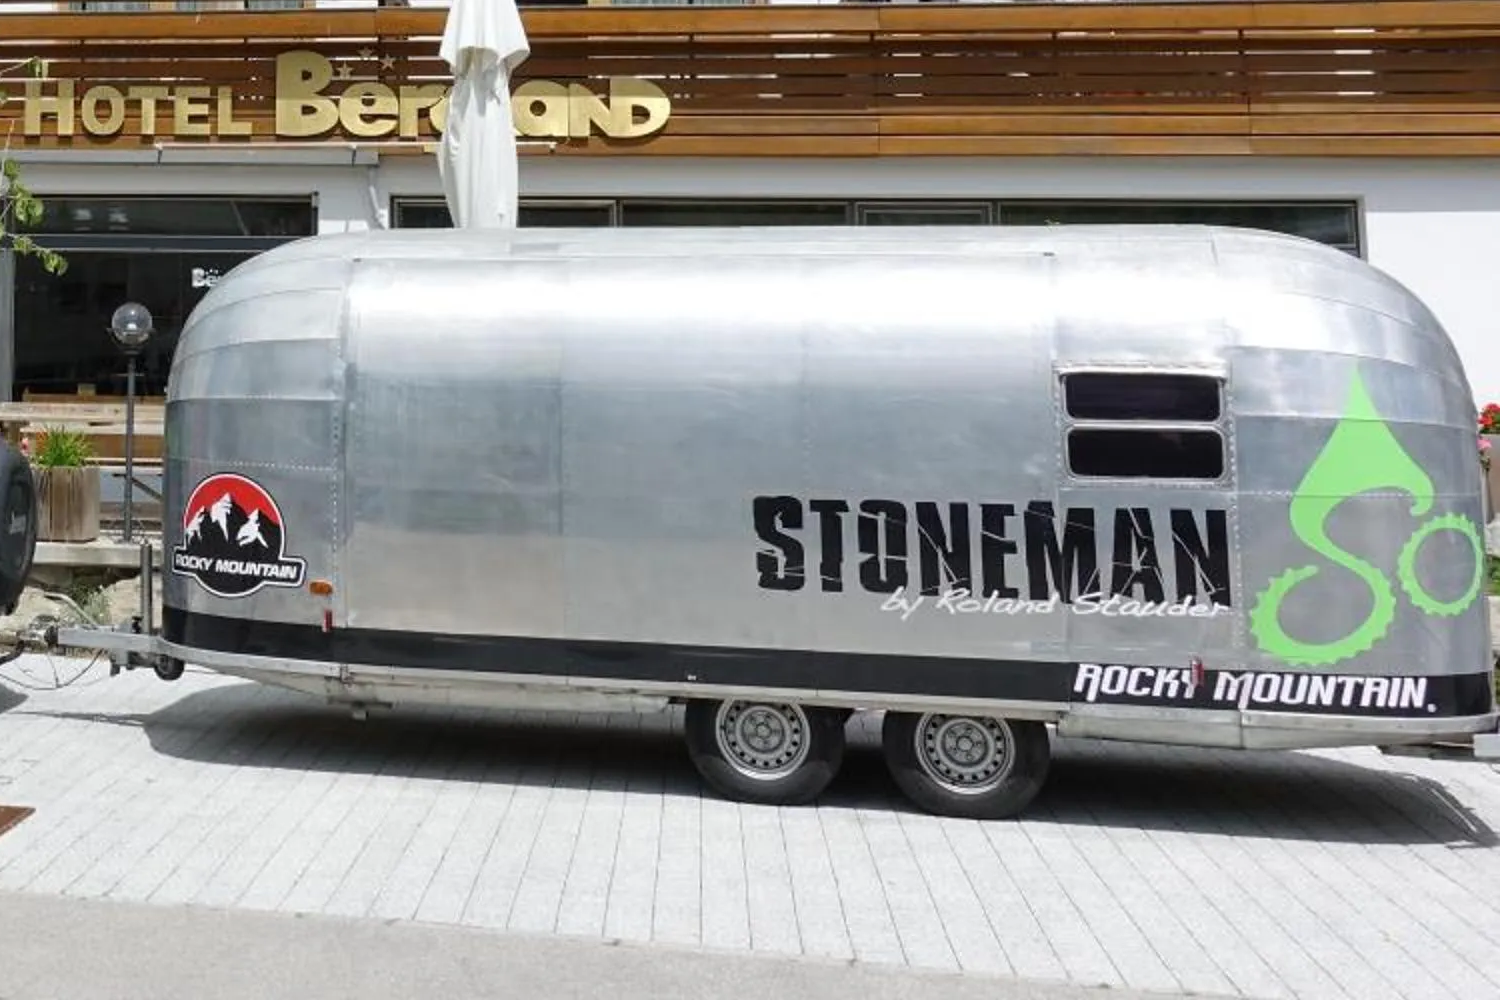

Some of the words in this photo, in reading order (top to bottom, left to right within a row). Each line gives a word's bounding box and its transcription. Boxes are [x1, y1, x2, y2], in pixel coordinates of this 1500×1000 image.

[23, 79, 253, 136] HOTEL
[175, 553, 213, 571] ROCKY
[215, 560, 298, 579] MOUNTAIN
[752, 495, 1232, 607] STONEMAN
[880, 587, 921, 621] by
[930, 587, 1056, 616] Roland
[1070, 593, 1232, 618] Stauder
[1074, 663, 1198, 702] ROCKY
